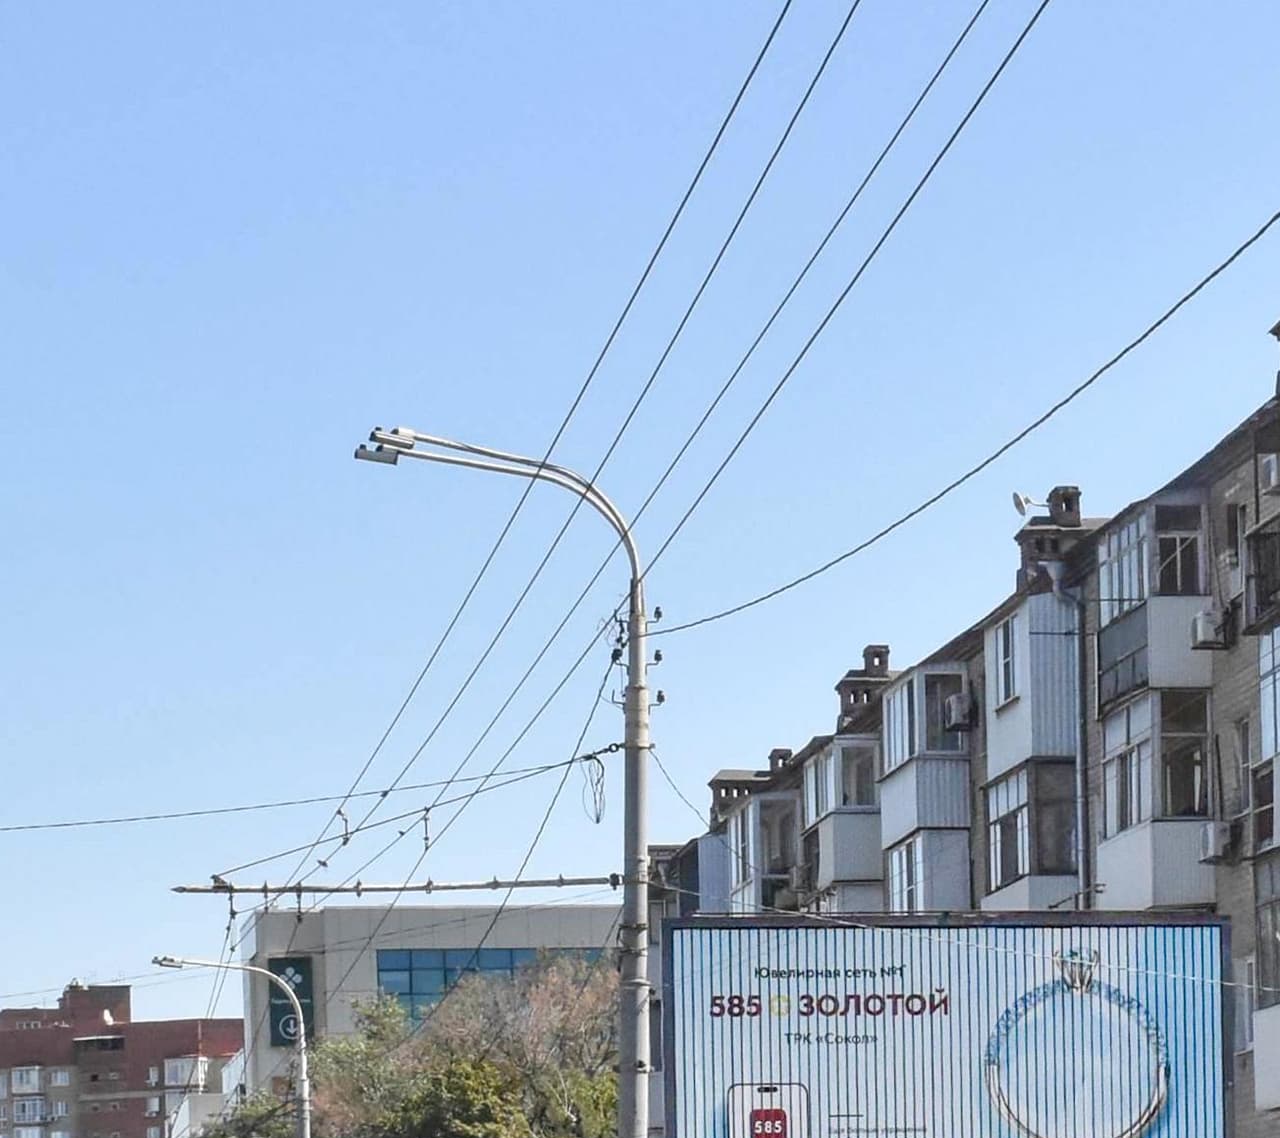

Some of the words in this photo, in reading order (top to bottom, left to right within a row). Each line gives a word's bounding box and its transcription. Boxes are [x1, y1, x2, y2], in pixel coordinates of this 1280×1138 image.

[754, 966, 841, 980] Ювелирная
[844, 968, 877, 979] сеть
[709, 995, 762, 1017] 585
[798, 986, 949, 1018] ЗОЛОТОЙ
[783, 1033, 812, 1045] ТРК
[753, 1121, 783, 1134] 585
